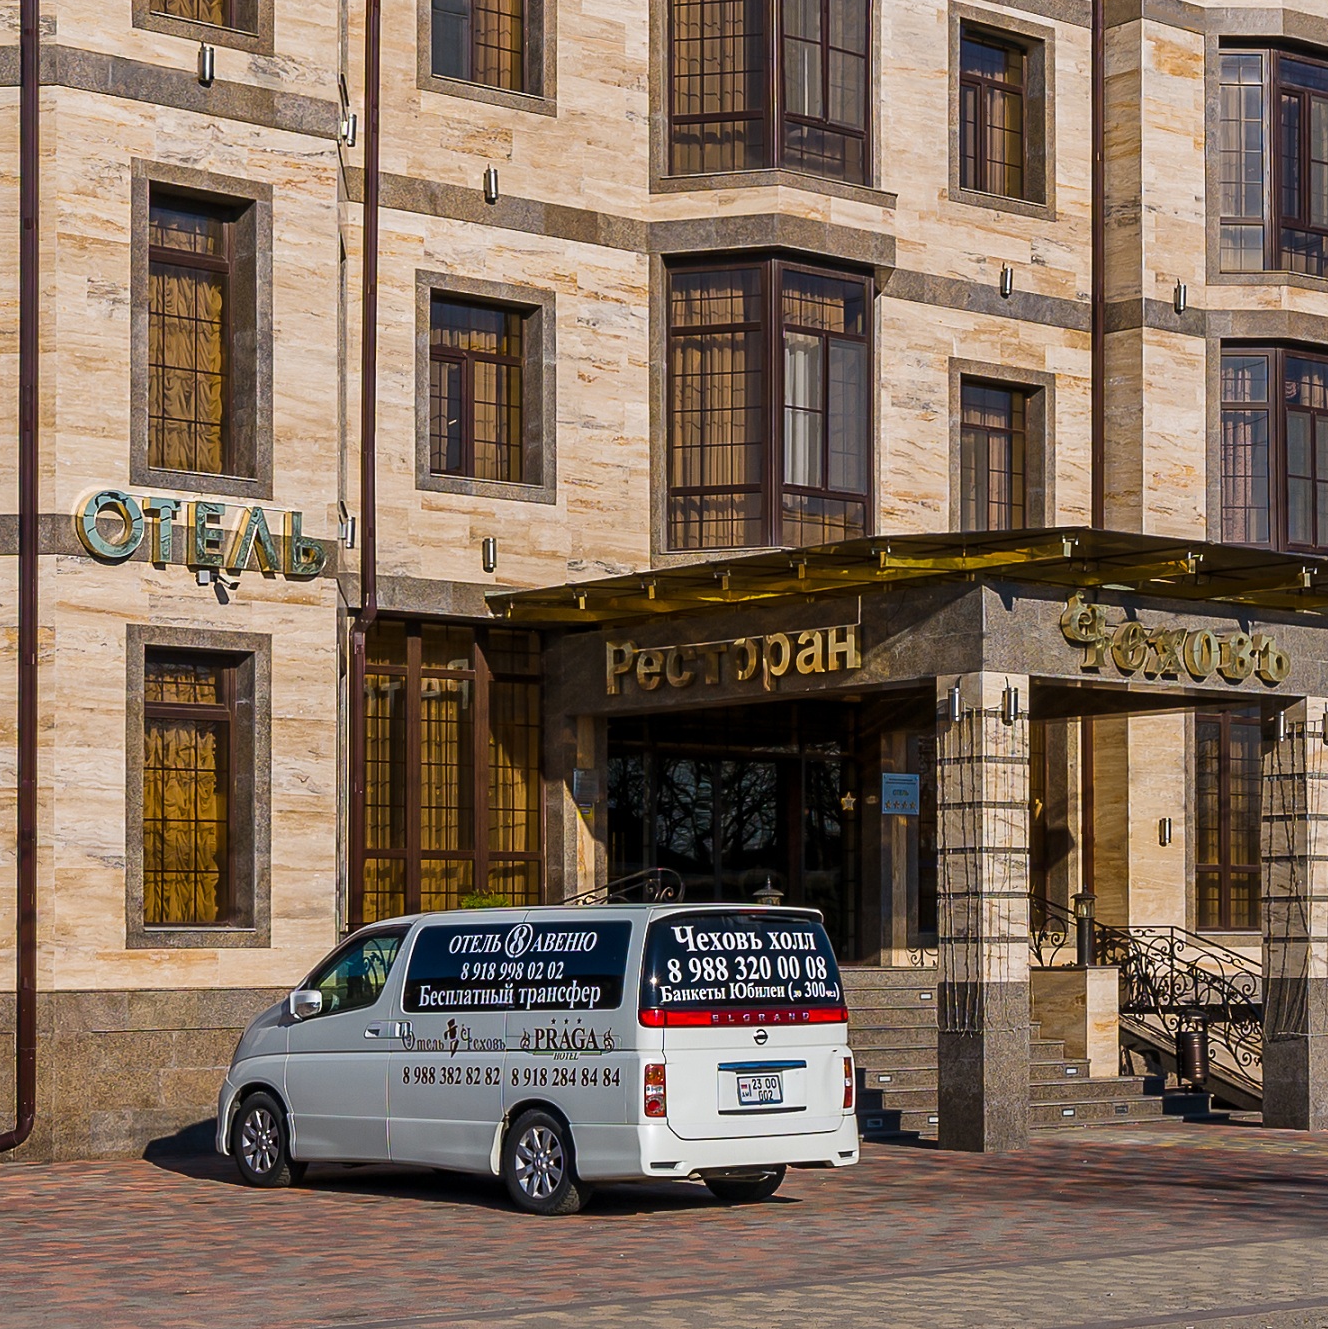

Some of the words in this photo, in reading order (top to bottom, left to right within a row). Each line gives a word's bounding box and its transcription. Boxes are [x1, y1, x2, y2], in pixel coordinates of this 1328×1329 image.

[76, 489, 327, 576] ОТЕЛЬ
[1060, 591, 1291, 682] Чеховъ
[606, 625, 862, 695] Ресторан
[449, 934, 502, 954] ОТЕЛЬ
[530, 932, 598, 952] АВЕНЮ
[671, 925, 763, 952] Чеховъ
[767, 931, 817, 951] холл
[460, 962, 470, 980] 8
[473, 962, 496, 980] 918
[498, 961, 524, 980] 998
[527, 961, 544, 980] 02
[547, 961, 564, 980] 02
[667, 958, 682, 983] 8
[688, 956, 729, 983] 988
[734, 955, 771, 981] 320
[777, 955, 800, 980] 00
[805, 955, 828, 980] 08
[419, 983, 514, 1007] Бесплатный
[519, 980, 601, 1009] трансфер
[659, 985, 726, 1003] Банкеты
[712, 1012, 810, 1022] ELGRAND
[402, 1030, 445, 1050] Отель
[534, 1027, 599, 1050] PRAGA
[553, 1052, 579, 1061] HOTEL
[402, 1066, 410, 1085] 8
[413, 1066, 436, 1085] 988
[439, 1067, 462, 1085] 382
[465, 1067, 481, 1085] 82
[484, 1067, 501, 1085] 82
[511, 1068, 519, 1087] 8
[523, 1068, 548, 1087] 918
[552, 1068, 576, 1087] 284
[581, 1068, 598, 1087] 84
[602, 1068, 621, 1087] 84
[752, 1078, 762, 1090] 23
